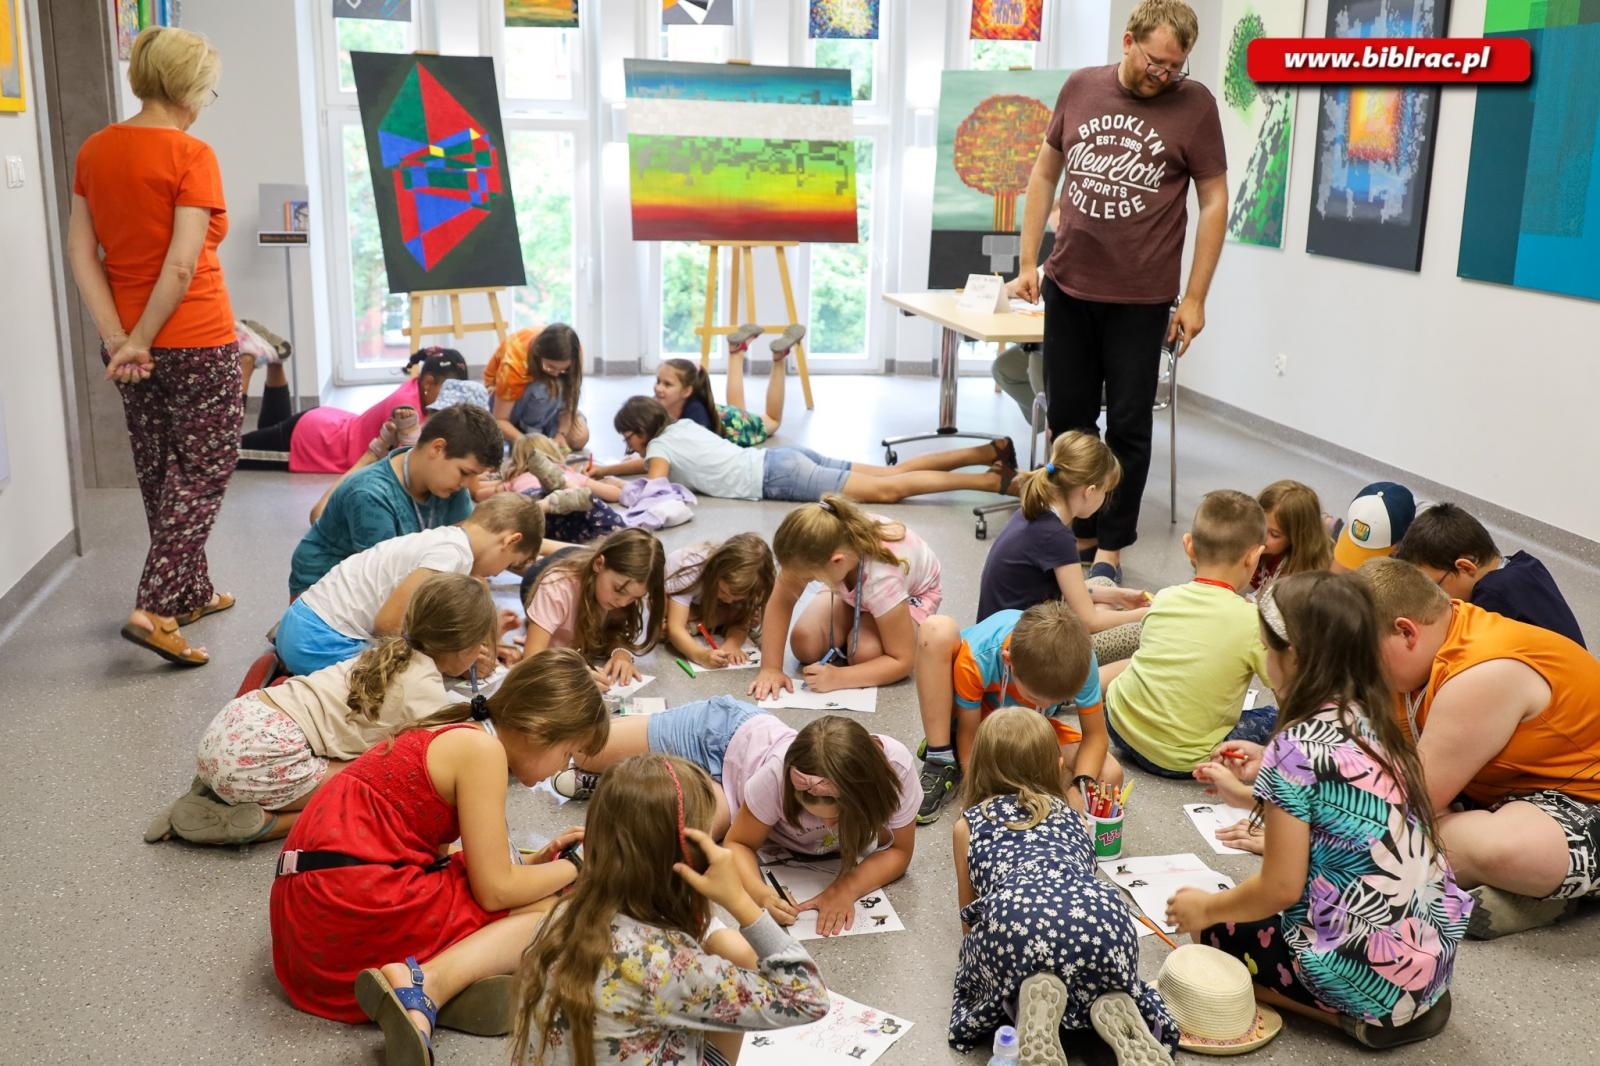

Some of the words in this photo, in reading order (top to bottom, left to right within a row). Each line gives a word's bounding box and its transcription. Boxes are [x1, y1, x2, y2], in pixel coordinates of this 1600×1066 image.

[1078, 114, 1166, 156] BROOKLYN
[1096, 135, 1117, 146] EST.
[1120, 136, 1143, 153] 1989
[1068, 181, 1146, 218] COLLEGE
[1082, 177, 1128, 198] SPORTS
